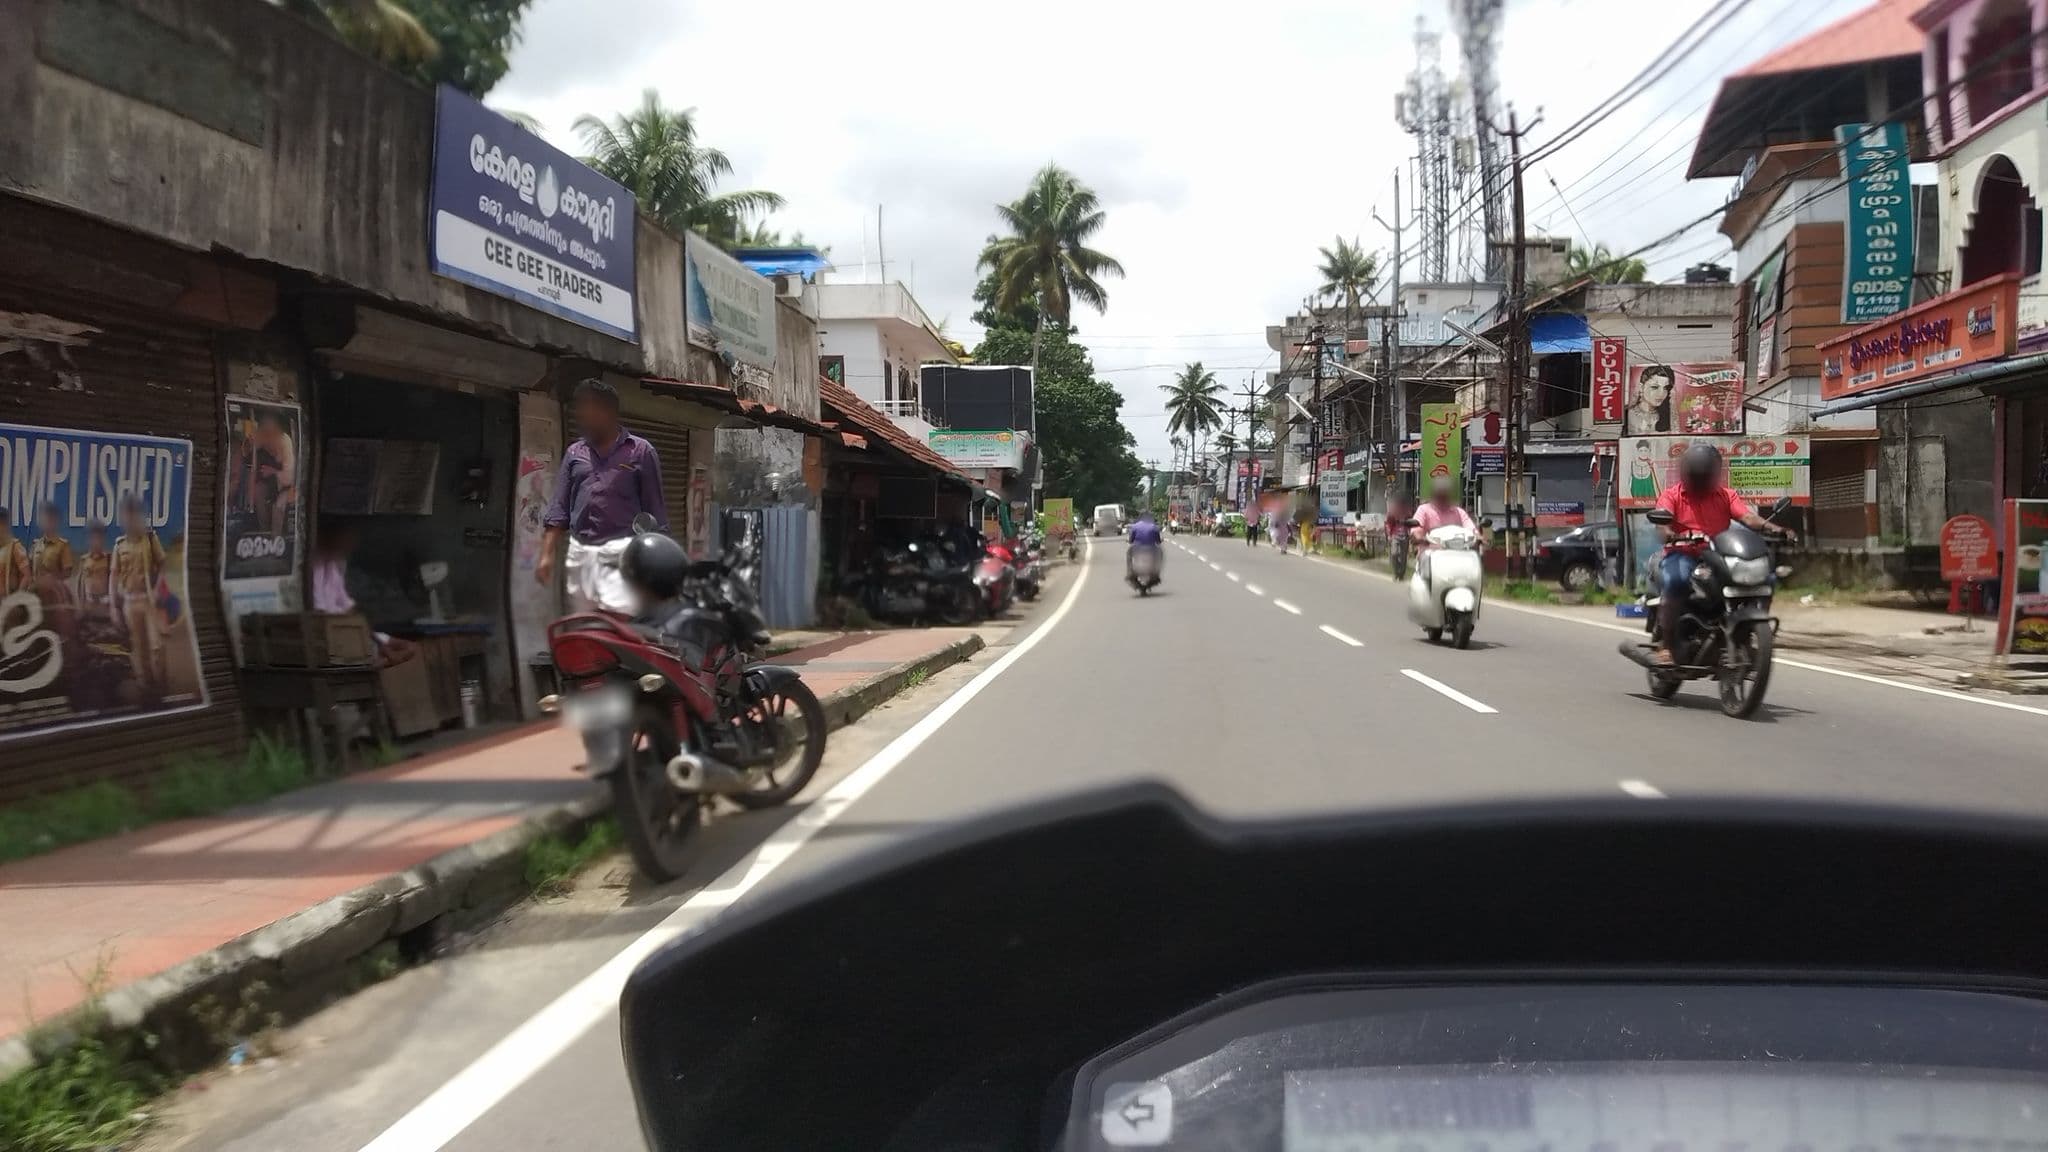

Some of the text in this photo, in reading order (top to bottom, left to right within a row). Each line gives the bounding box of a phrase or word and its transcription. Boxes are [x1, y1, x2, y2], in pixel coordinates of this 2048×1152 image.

[470, 134, 536, 205] കേരള
[478, 195, 503, 226] ഒരു
[484, 237, 603, 305] CEE GEE TRADERS
[1597, 342, 1621, 420] buhari
